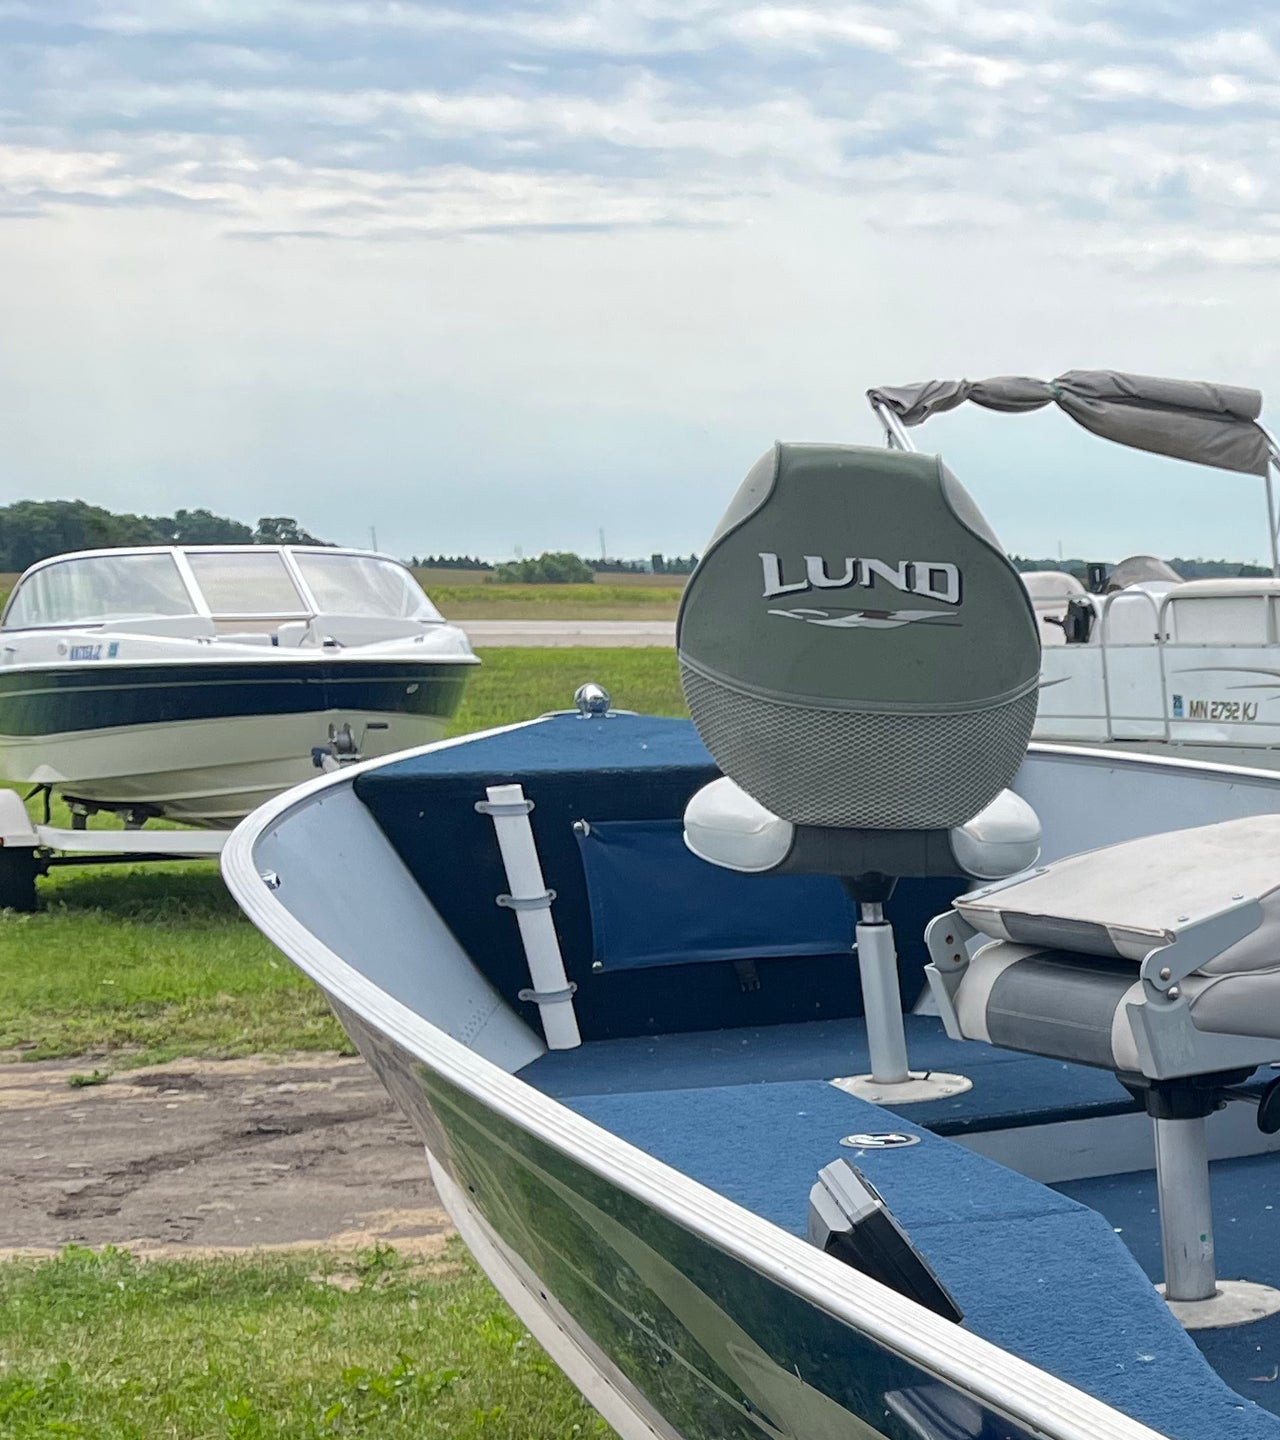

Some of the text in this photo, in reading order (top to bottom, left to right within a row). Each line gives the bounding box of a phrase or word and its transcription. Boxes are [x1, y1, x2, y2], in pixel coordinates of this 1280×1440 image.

[757, 552, 963, 606] LUND
[1188, 700, 1208, 718] MN
[1210, 701, 1240, 720] 2792
[1242, 702, 1259, 721] KJ
